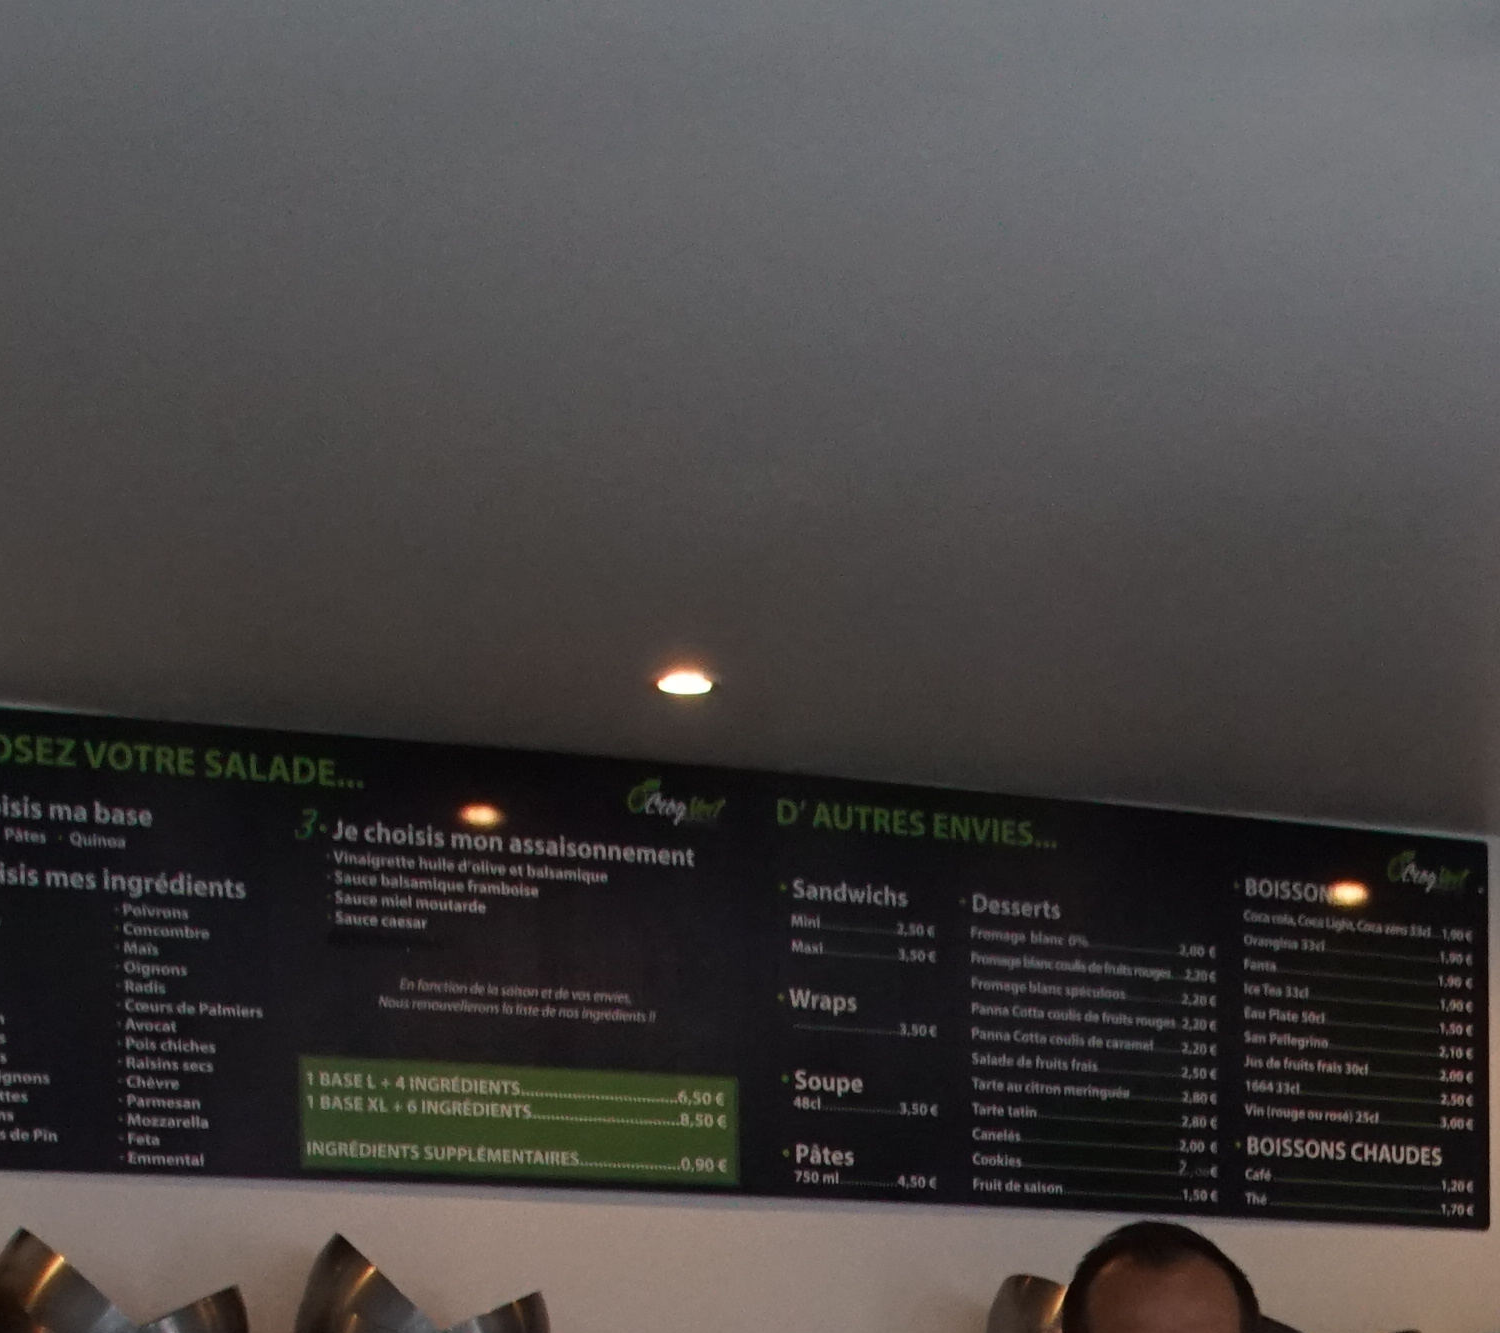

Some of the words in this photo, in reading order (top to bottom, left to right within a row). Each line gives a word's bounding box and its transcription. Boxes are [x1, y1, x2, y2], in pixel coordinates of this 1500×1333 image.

[85, 740, 195, 776] VOTRE
[50, 805, 87, 823] ma
[95, 801, 153, 827] base
[813, 802, 925, 837] AUTRES
[4, 826, 47, 845] Pâtes
[69, 831, 126, 849] Quinoa
[333, 819, 358, 843] Je
[364, 821, 445, 848] choisis
[452, 834, 503, 853] mon
[510, 836, 696, 868] assaisonnement
[334, 851, 415, 870] Vinaigrette
[418, 855, 454, 873] huile
[458, 858, 506, 876] d'olive
[526, 864, 608, 885] balsamique
[45, 869, 96, 890] mes
[103, 868, 247, 900] ingrédients
[334, 871, 377, 887] Sauce
[381, 874, 464, 894] balsamique
[467, 880, 539, 898] framboise
[792, 878, 909, 908] Sandwichs
[1245, 877, 1340, 904] BOISSON
[334, 891, 377, 907] Sauce
[381, 894, 411, 911] miel
[415, 897, 487, 914] moutarde
[972, 892, 1062, 920] Desserts
[122, 904, 189, 920] Poivrons
[334, 912, 378, 926] Sauce
[381, 917, 428, 930] caesar
[790, 914, 821, 929] Mini
[123, 923, 210, 940] Concombre
[970, 926, 1025, 944] Fromage
[1030, 930, 1063, 945] blanc
[791, 939, 823, 954] Maxi
[1244, 934, 1299, 950] Orangina
[124, 961, 188, 978] Oignons
[1244, 959, 1276, 972] Fanta
[124, 981, 166, 995] Radis
[1244, 984, 1260, 995] Ice
[1263, 984, 1282, 997] Tea
[177, 1001, 195, 1015] de
[199, 1002, 263, 1019] Palmiers
[789, 988, 857, 1016] Wraps
[971, 1002, 1009, 1017] Panna
[1012, 1005, 1044, 1019] Cotta
[1047, 1007, 1081, 1022] coulis
[1084, 1010, 1099, 1023] de
[1102, 1012, 1133, 1025] fruits
[1136, 1017, 1175, 1031] rouges
[125, 1019, 177, 1034] Avocat
[125, 1038, 156, 1052] Pois
[160, 1039, 216, 1055] chiches
[1244, 1032, 1266, 1044] San
[1269, 1033, 1329, 1050] Pellegrino
[126, 1057, 178, 1072] Raisins
[183, 1061, 214, 1073] secs
[971, 1053, 1014, 1067] Salade
[1017, 1056, 1032, 1068] de
[1036, 1056, 1068, 1071] fruits
[1071, 1060, 1098, 1073] frais
[1244, 1056, 1263, 1069] Jus
[1266, 1057, 1281, 1069] de
[1284, 1058, 1314, 1073] fruits
[1318, 1060, 1342, 1074] frais
[126, 1076, 180, 1090] Chèvre
[320, 1073, 362, 1088] BASE
[368, 1076, 376, 1089] L
[396, 1077, 405, 1090] 4
[678, 1091, 711, 1107] 6,50
[794, 1069, 864, 1098] Soupe
[971, 1077, 1004, 1092] Tarte
[1007, 1083, 1022, 1093] au
[1025, 1082, 1061, 1096] citron
[1064, 1085, 1130, 1101] meringuée
[126, 1095, 201, 1110] Parmesan
[794, 1096, 821, 1110] 48cl
[900, 1102, 928, 1117] 3,50
[972, 1103, 1004, 1117] Tarte
[1007, 1106, 1037, 1119] tatin
[127, 1114, 209, 1129] Mozzarella
[320, 1097, 364, 1111] BASE
[368, 1098, 387, 1113] XL
[408, 1100, 417, 1114] 6
[680, 1115, 713, 1129] 8,50
[10, 1128, 29, 1141] de
[33, 1129, 58, 1143] Pin
[127, 1133, 160, 1147] Feta
[972, 1128, 1021, 1142] Canelés
[127, 1152, 205, 1167] Emmental
[306, 1140, 419, 1161] INGRÉDIENTS
[680, 1158, 714, 1173] 0,90
[795, 1143, 854, 1166] Pâtes
[1247, 1136, 1346, 1161] BOISSONS
[1351, 1142, 1442, 1166] CHAUDES
[972, 1153, 1022, 1168] Cookies
[794, 1170, 819, 1184] 750
[822, 1171, 839, 1185] ml
[897, 1175, 926, 1190] 4,50
[1245, 1168, 1272, 1182] Café
[973, 1178, 1002, 1192] Fruit
[1005, 1180, 1021, 1192] de
[1024, 1182, 1063, 1195] saison
[1245, 1192, 1267, 1206] Thé
